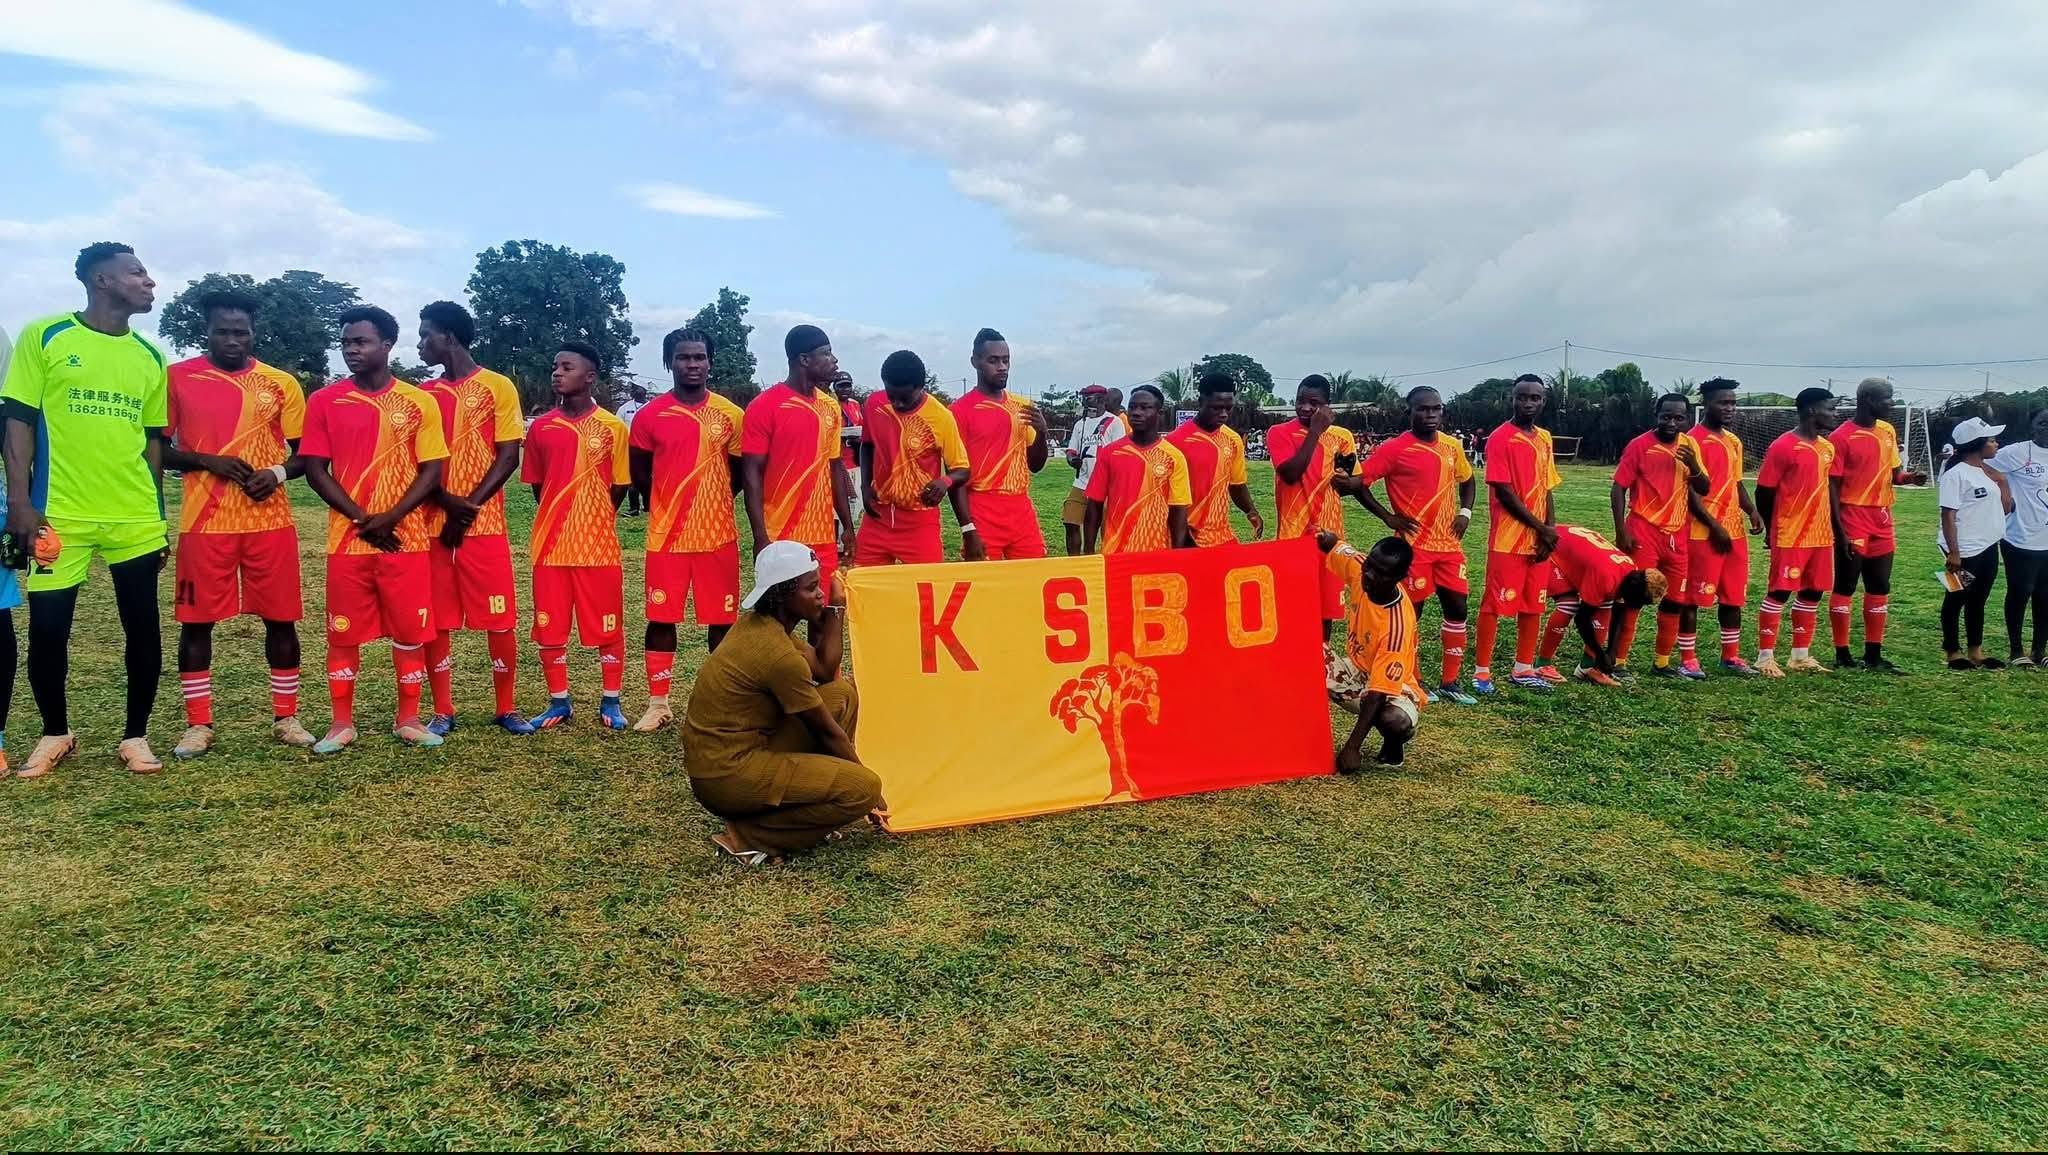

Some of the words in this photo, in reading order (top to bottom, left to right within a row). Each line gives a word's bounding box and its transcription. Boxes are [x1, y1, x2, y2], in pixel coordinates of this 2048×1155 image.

[489, 595, 505, 614] 18
[725, 594, 734, 612] 2
[418, 608, 427, 628] 7
[603, 614, 616, 633] 19
[1387, 661, 1403, 681] hp
